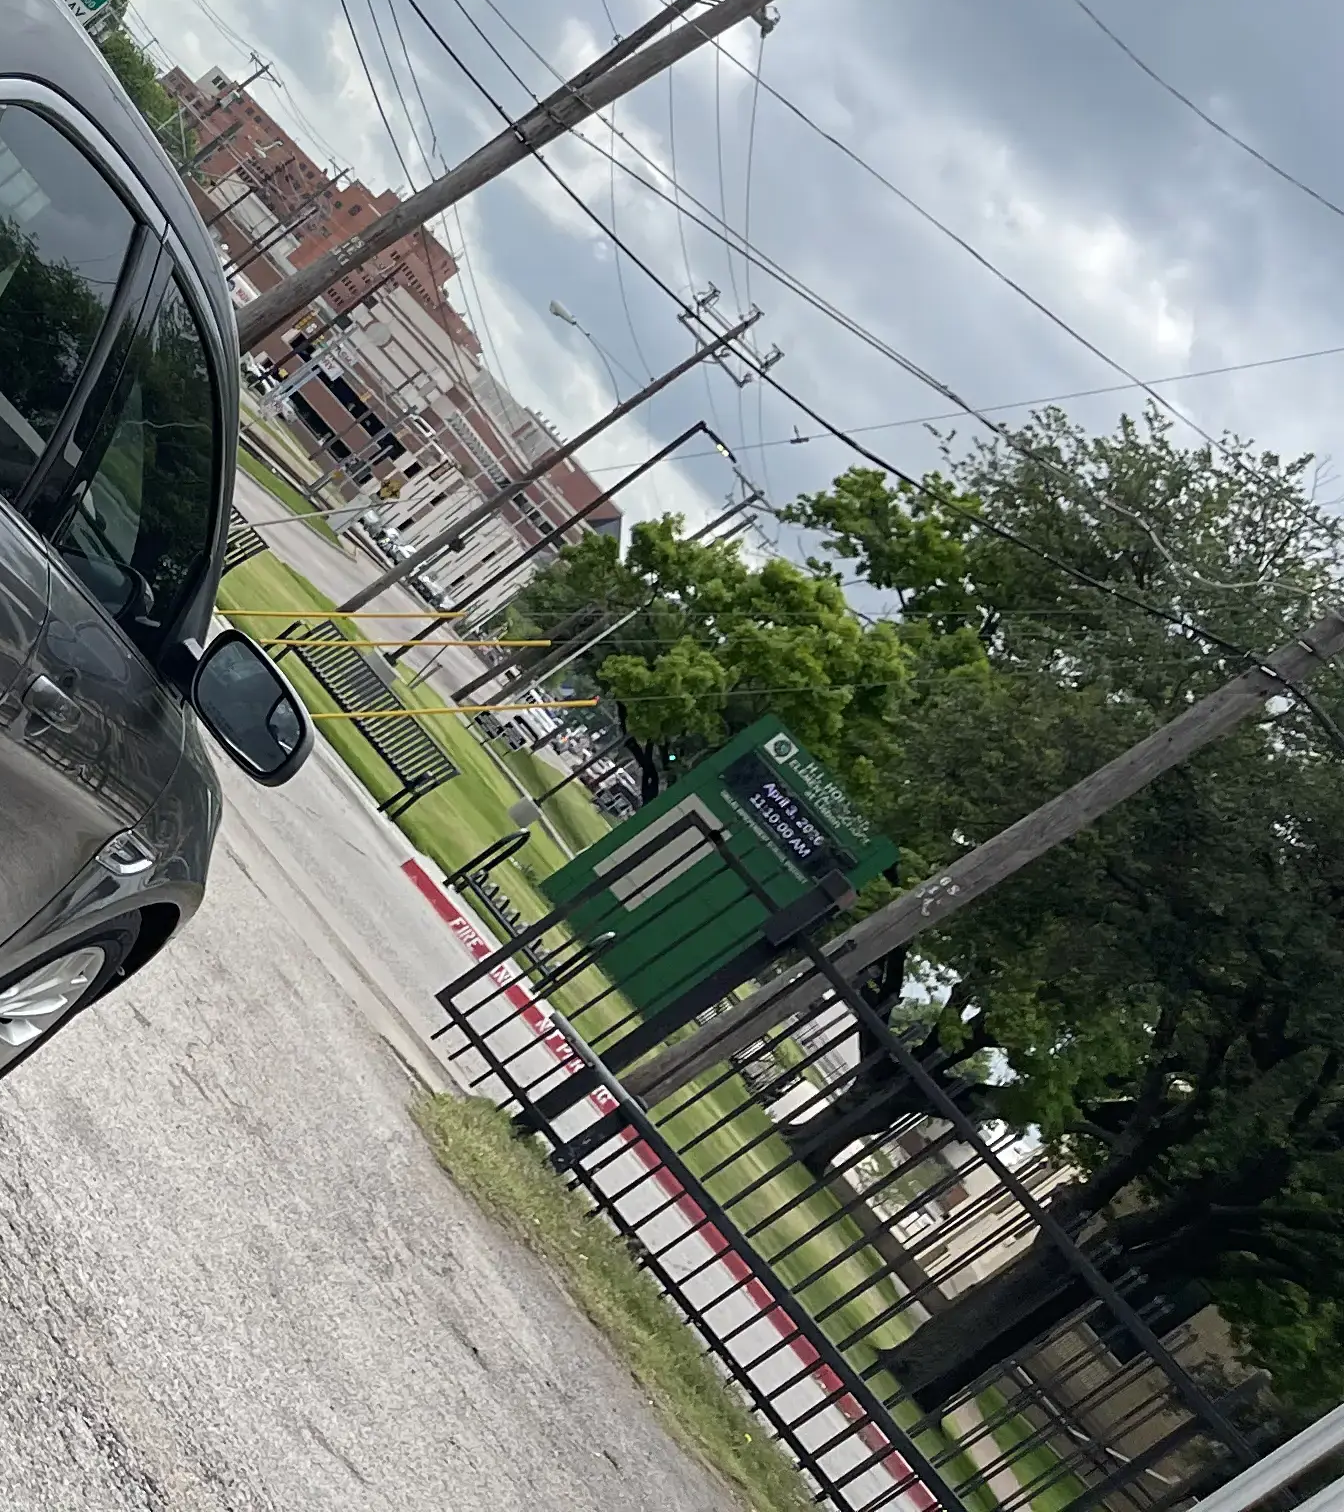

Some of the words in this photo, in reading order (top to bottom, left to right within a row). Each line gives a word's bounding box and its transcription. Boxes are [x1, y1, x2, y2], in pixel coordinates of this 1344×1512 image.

[763, 783, 791, 808] April
[789, 838, 811, 858] AM
[449, 918, 484, 951] FIRE
